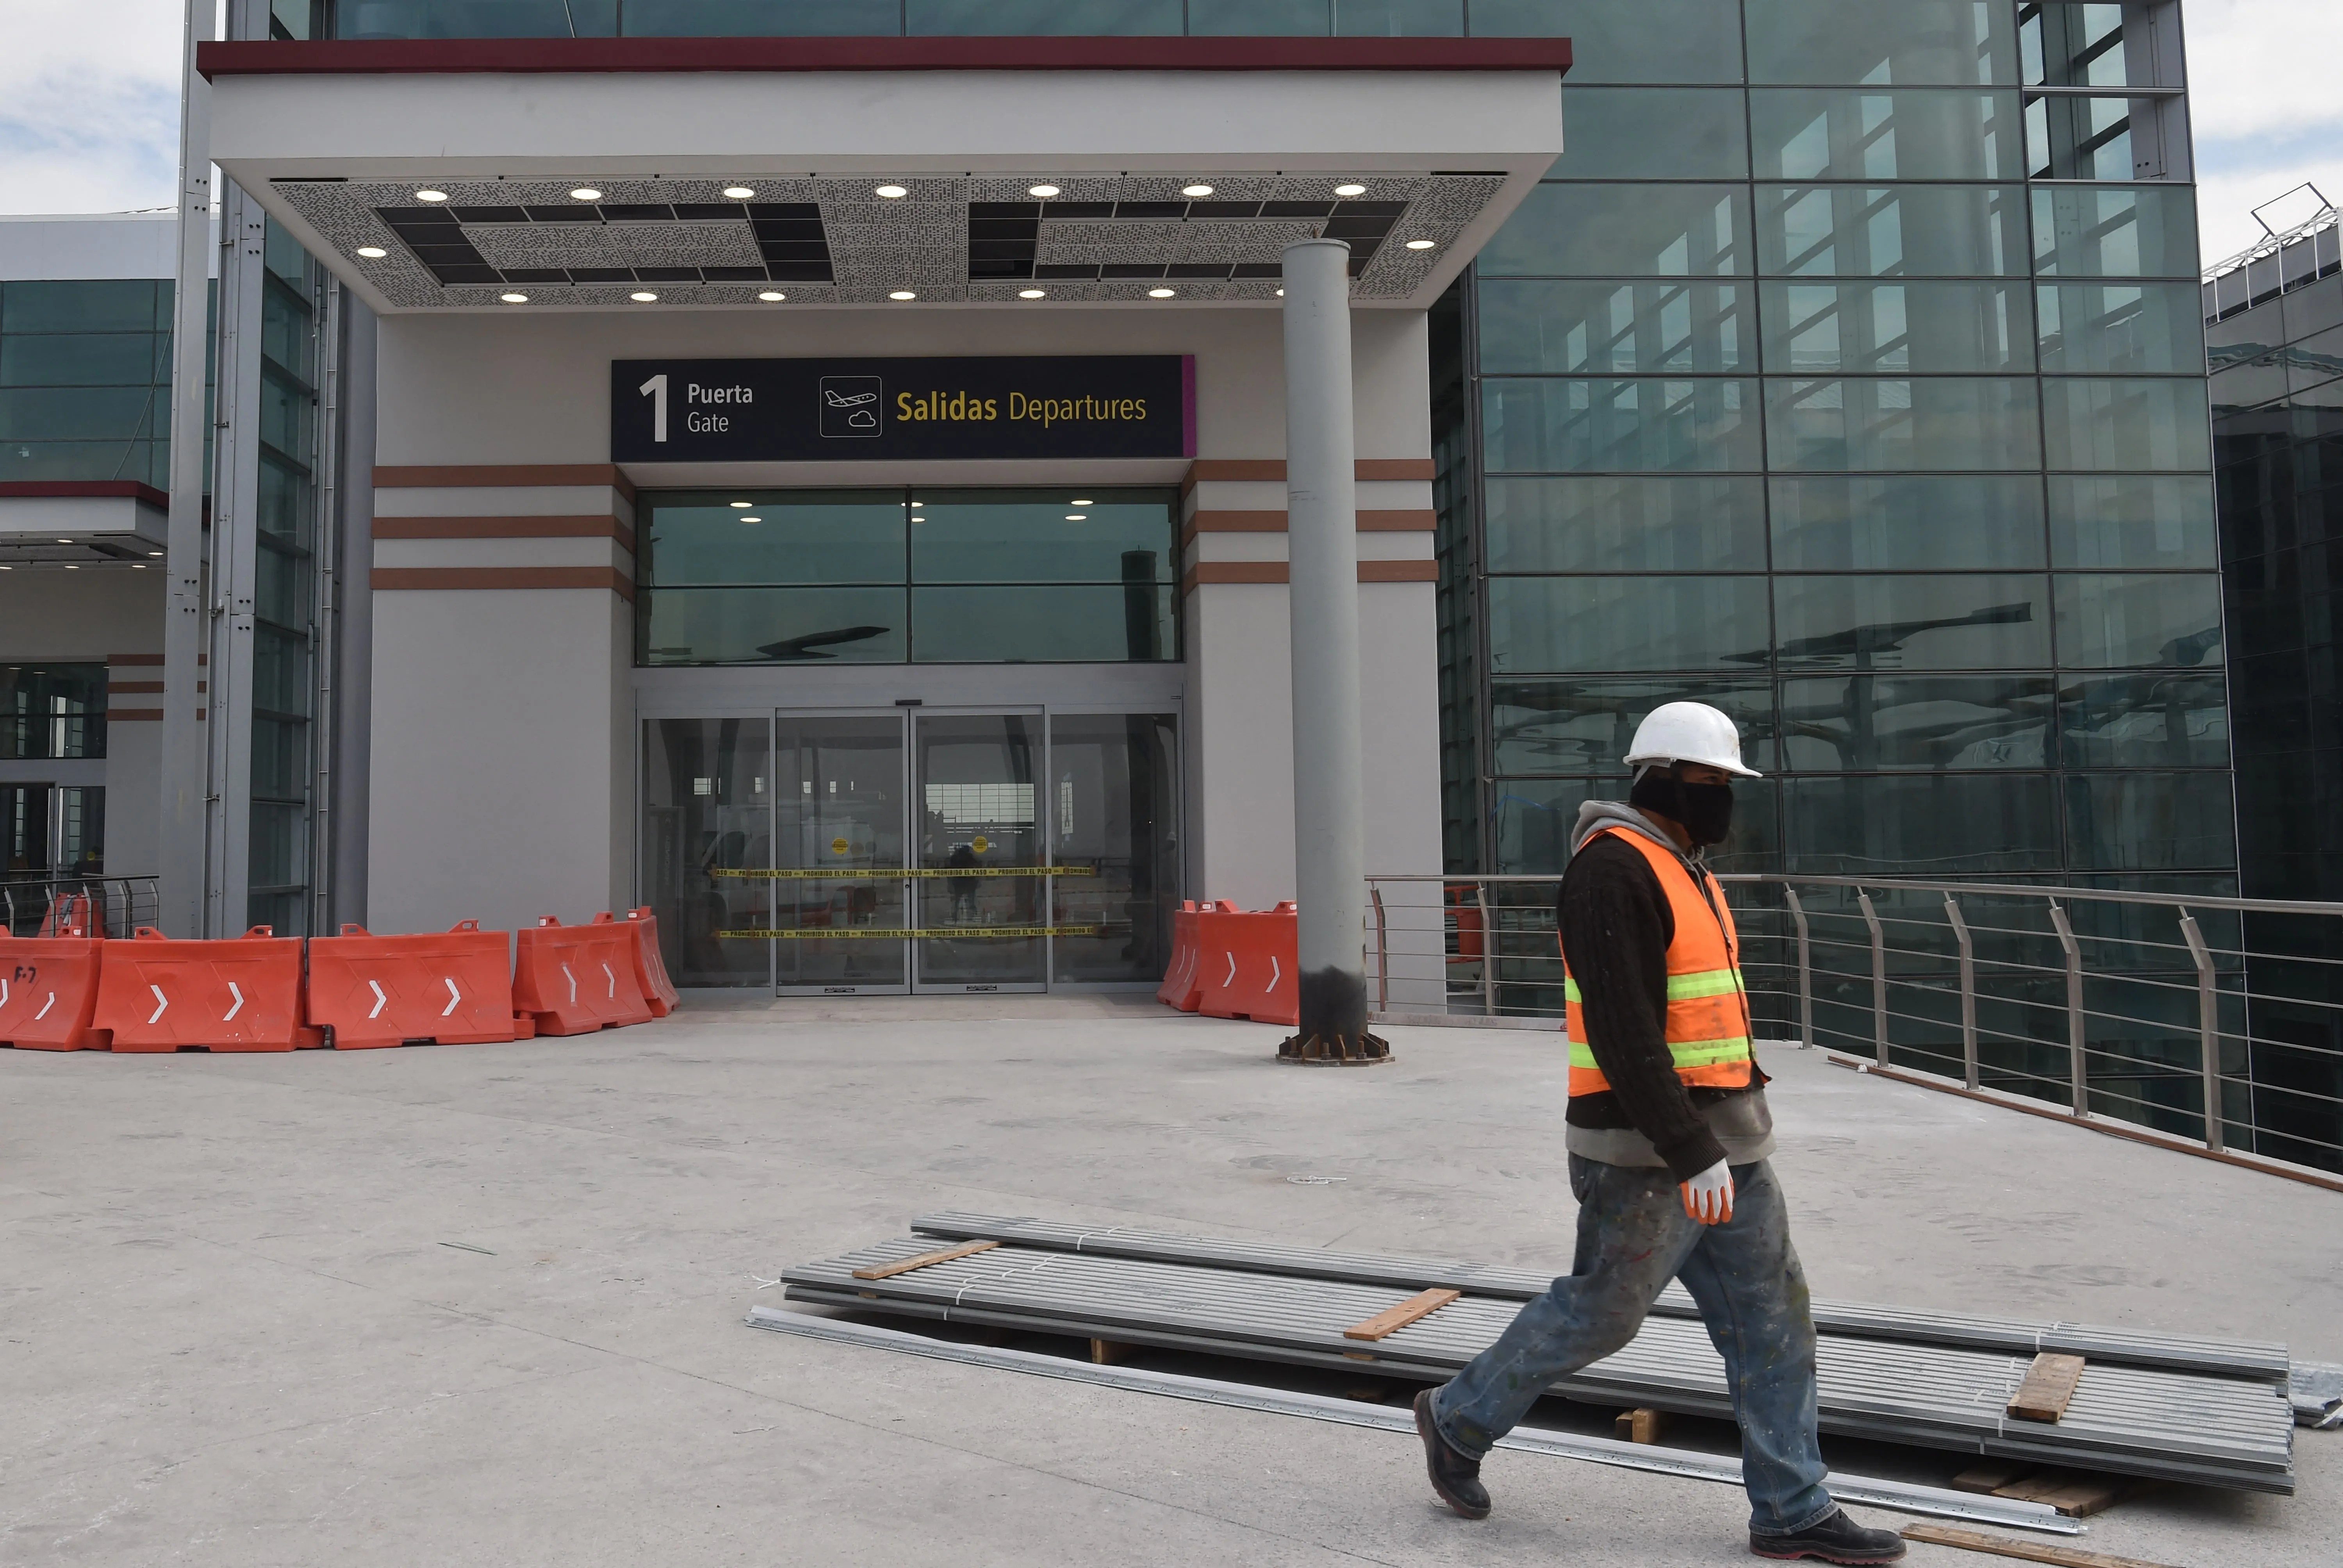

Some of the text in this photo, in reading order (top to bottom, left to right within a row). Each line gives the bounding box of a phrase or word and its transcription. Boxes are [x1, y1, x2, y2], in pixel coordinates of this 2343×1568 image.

[639, 374, 667, 442] 1
[688, 383, 753, 405] Puerta
[688, 412, 729, 433] Gate
[897, 392, 1147, 428] Salidas Departures
